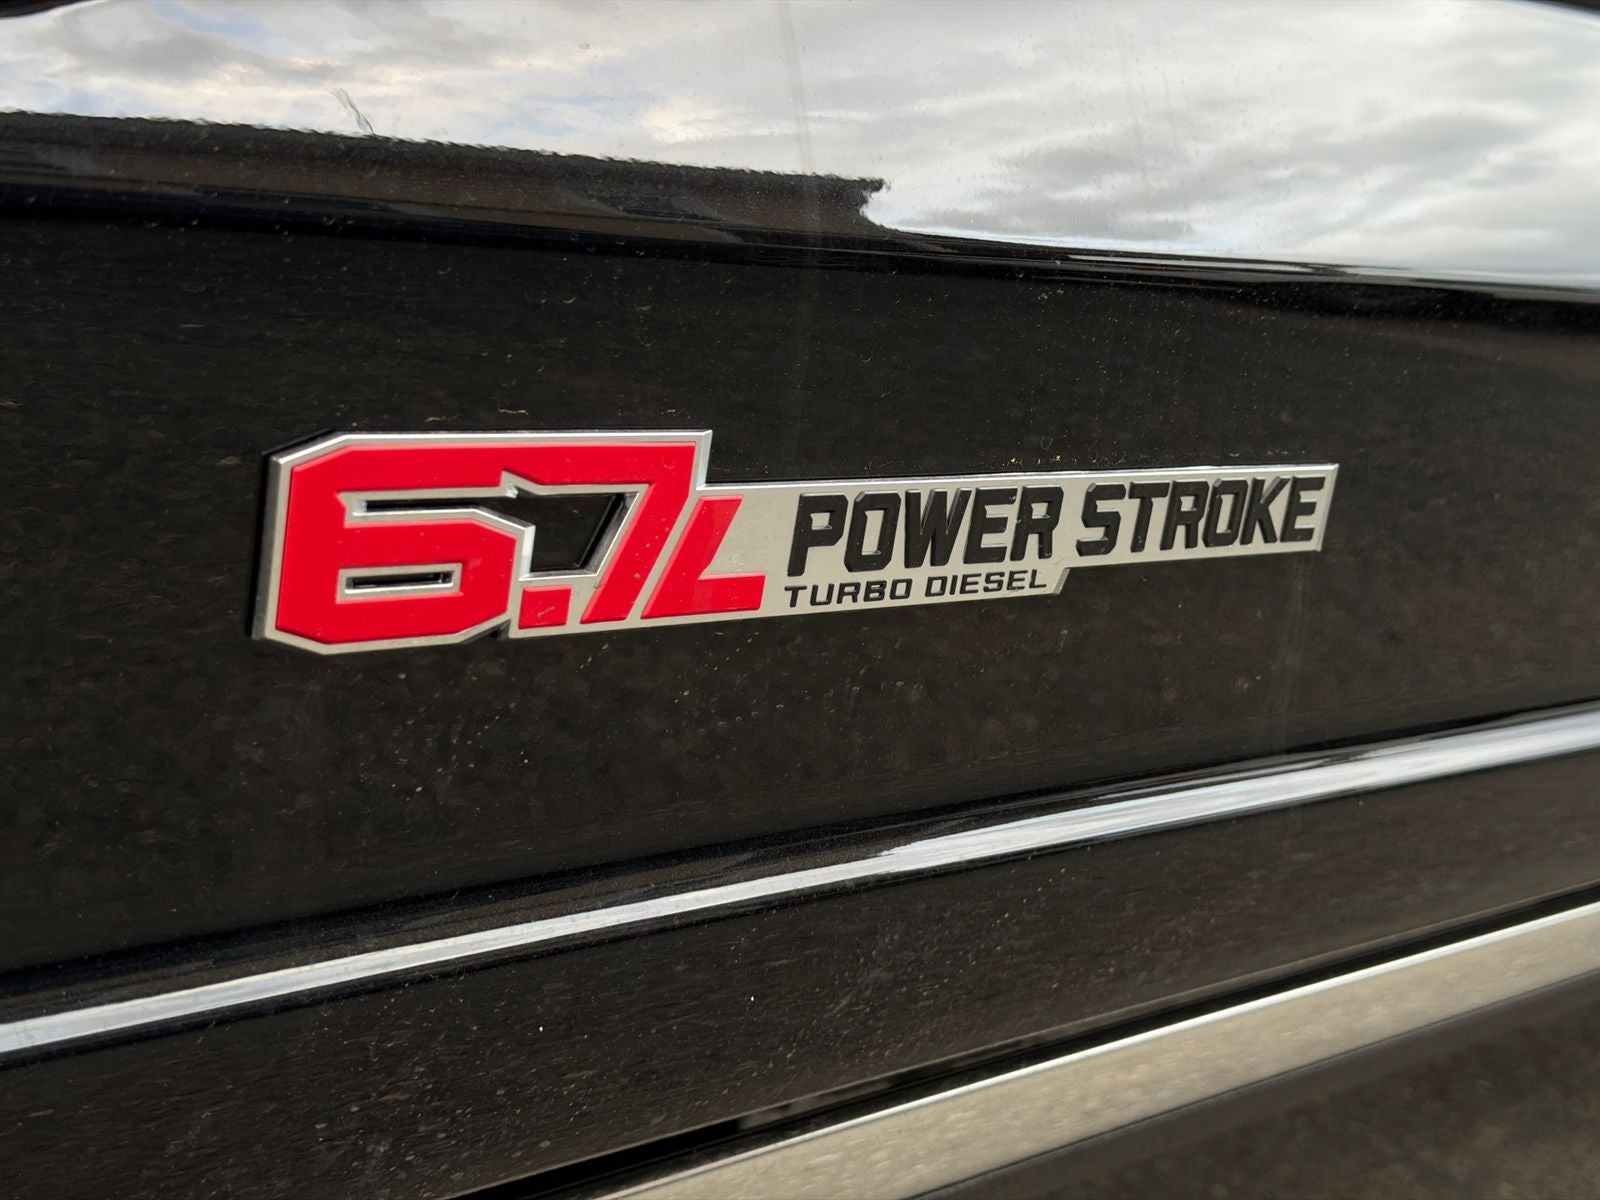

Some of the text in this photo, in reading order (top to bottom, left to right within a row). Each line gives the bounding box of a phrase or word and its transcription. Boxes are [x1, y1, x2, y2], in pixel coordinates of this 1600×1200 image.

[274, 441, 1326, 645] 6.7L POWER STROKE
[784, 568, 1047, 608] TURBO DIESEL
